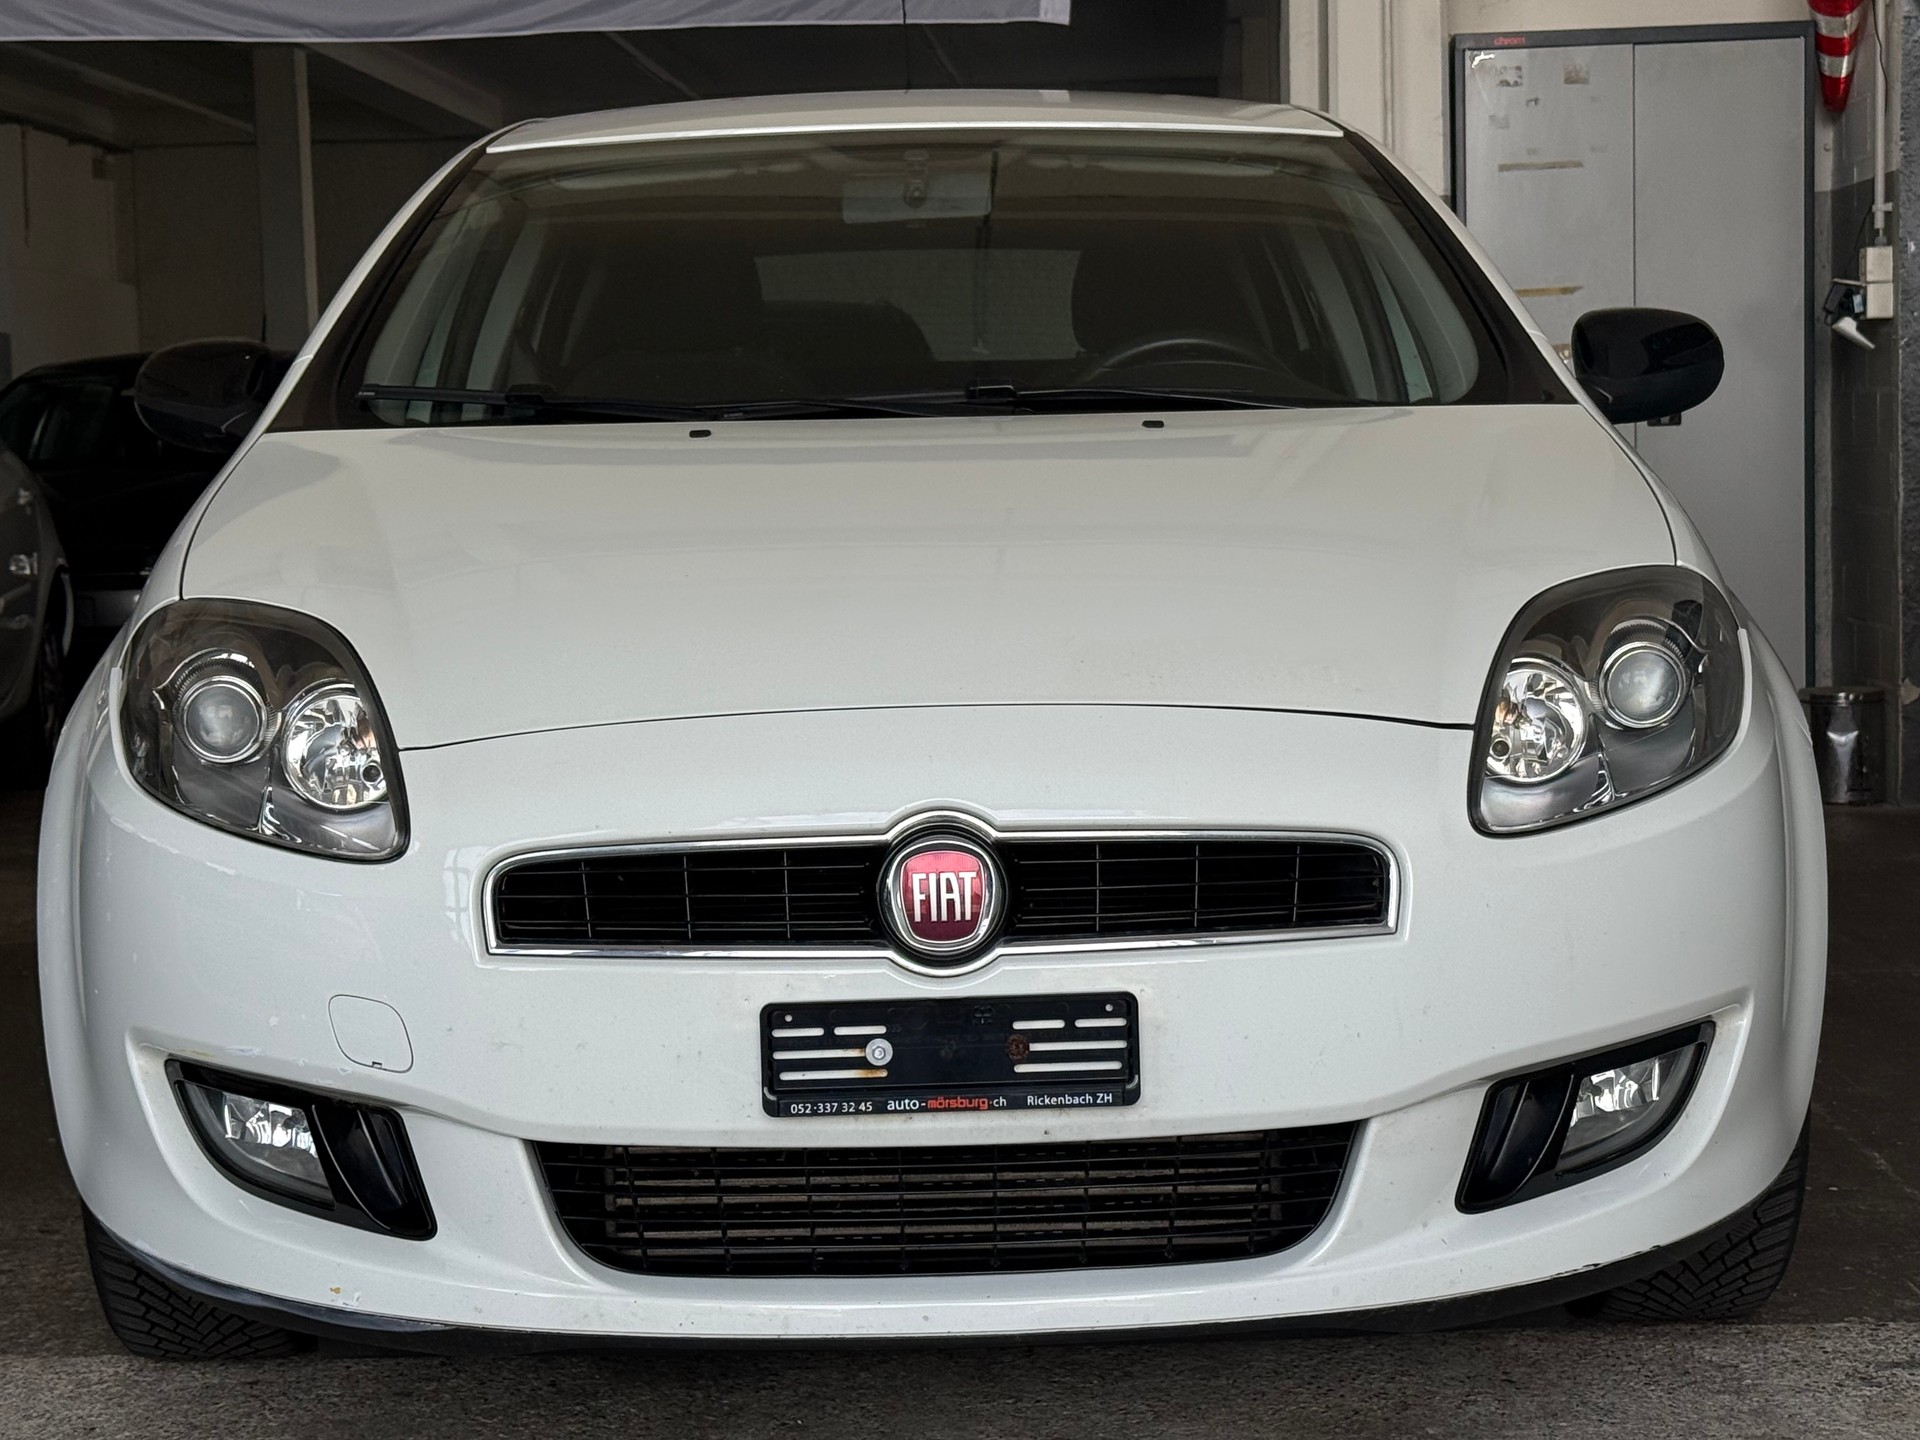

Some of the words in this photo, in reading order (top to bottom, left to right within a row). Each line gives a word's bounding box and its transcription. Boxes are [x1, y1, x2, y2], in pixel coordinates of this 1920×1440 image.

[912, 871, 977, 922] FIAT
[841, 1102, 856, 1113] 32
[858, 1101, 873, 1112] 45
[1027, 1093, 1093, 1106] Rickenbach
[1096, 1092, 1113, 1104] ZH
